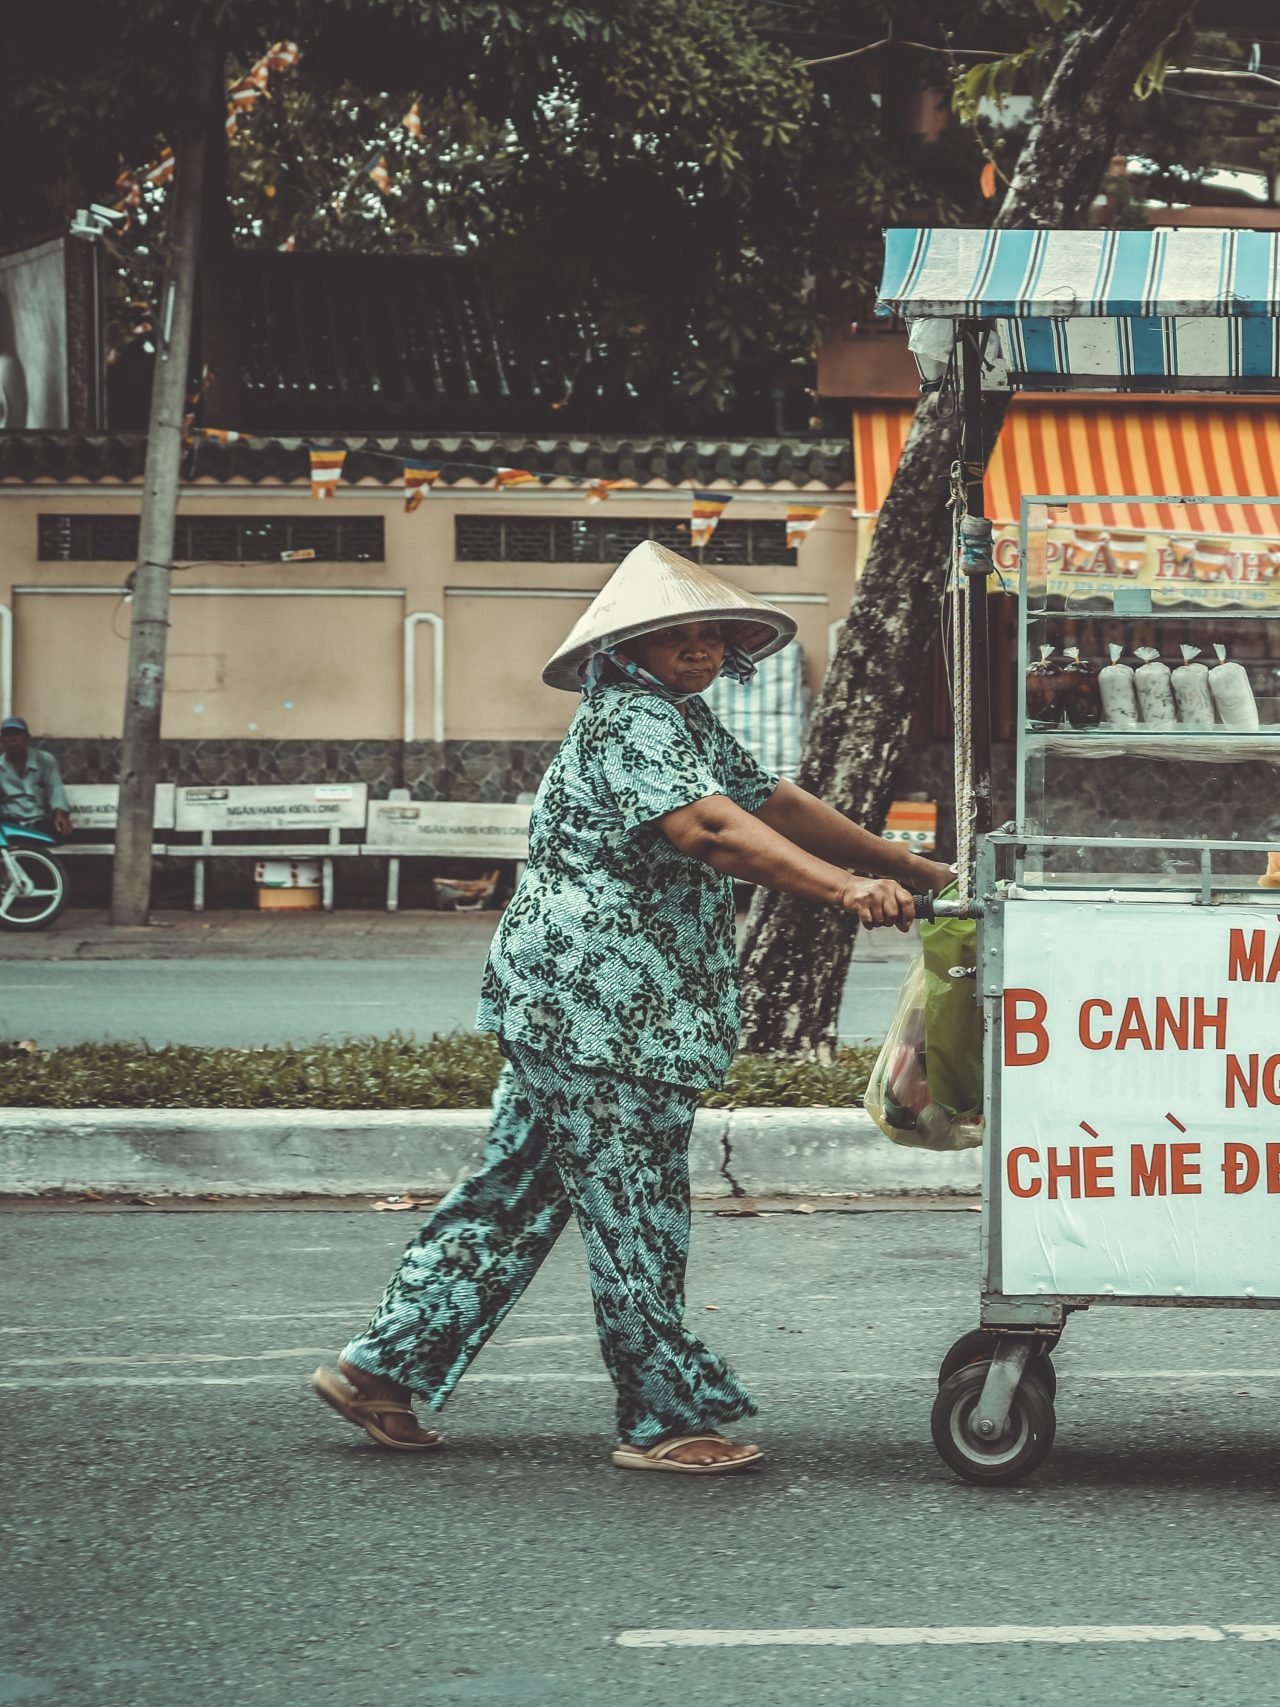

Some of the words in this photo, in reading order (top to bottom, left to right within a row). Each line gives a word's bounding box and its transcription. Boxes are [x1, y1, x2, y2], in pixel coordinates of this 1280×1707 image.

[1003, 987, 1050, 1067] B
[1078, 996, 1228, 1050] CANH
[1006, 1120, 1115, 1200] CHÈ
[1130, 1112, 1202, 1197] MÈ
